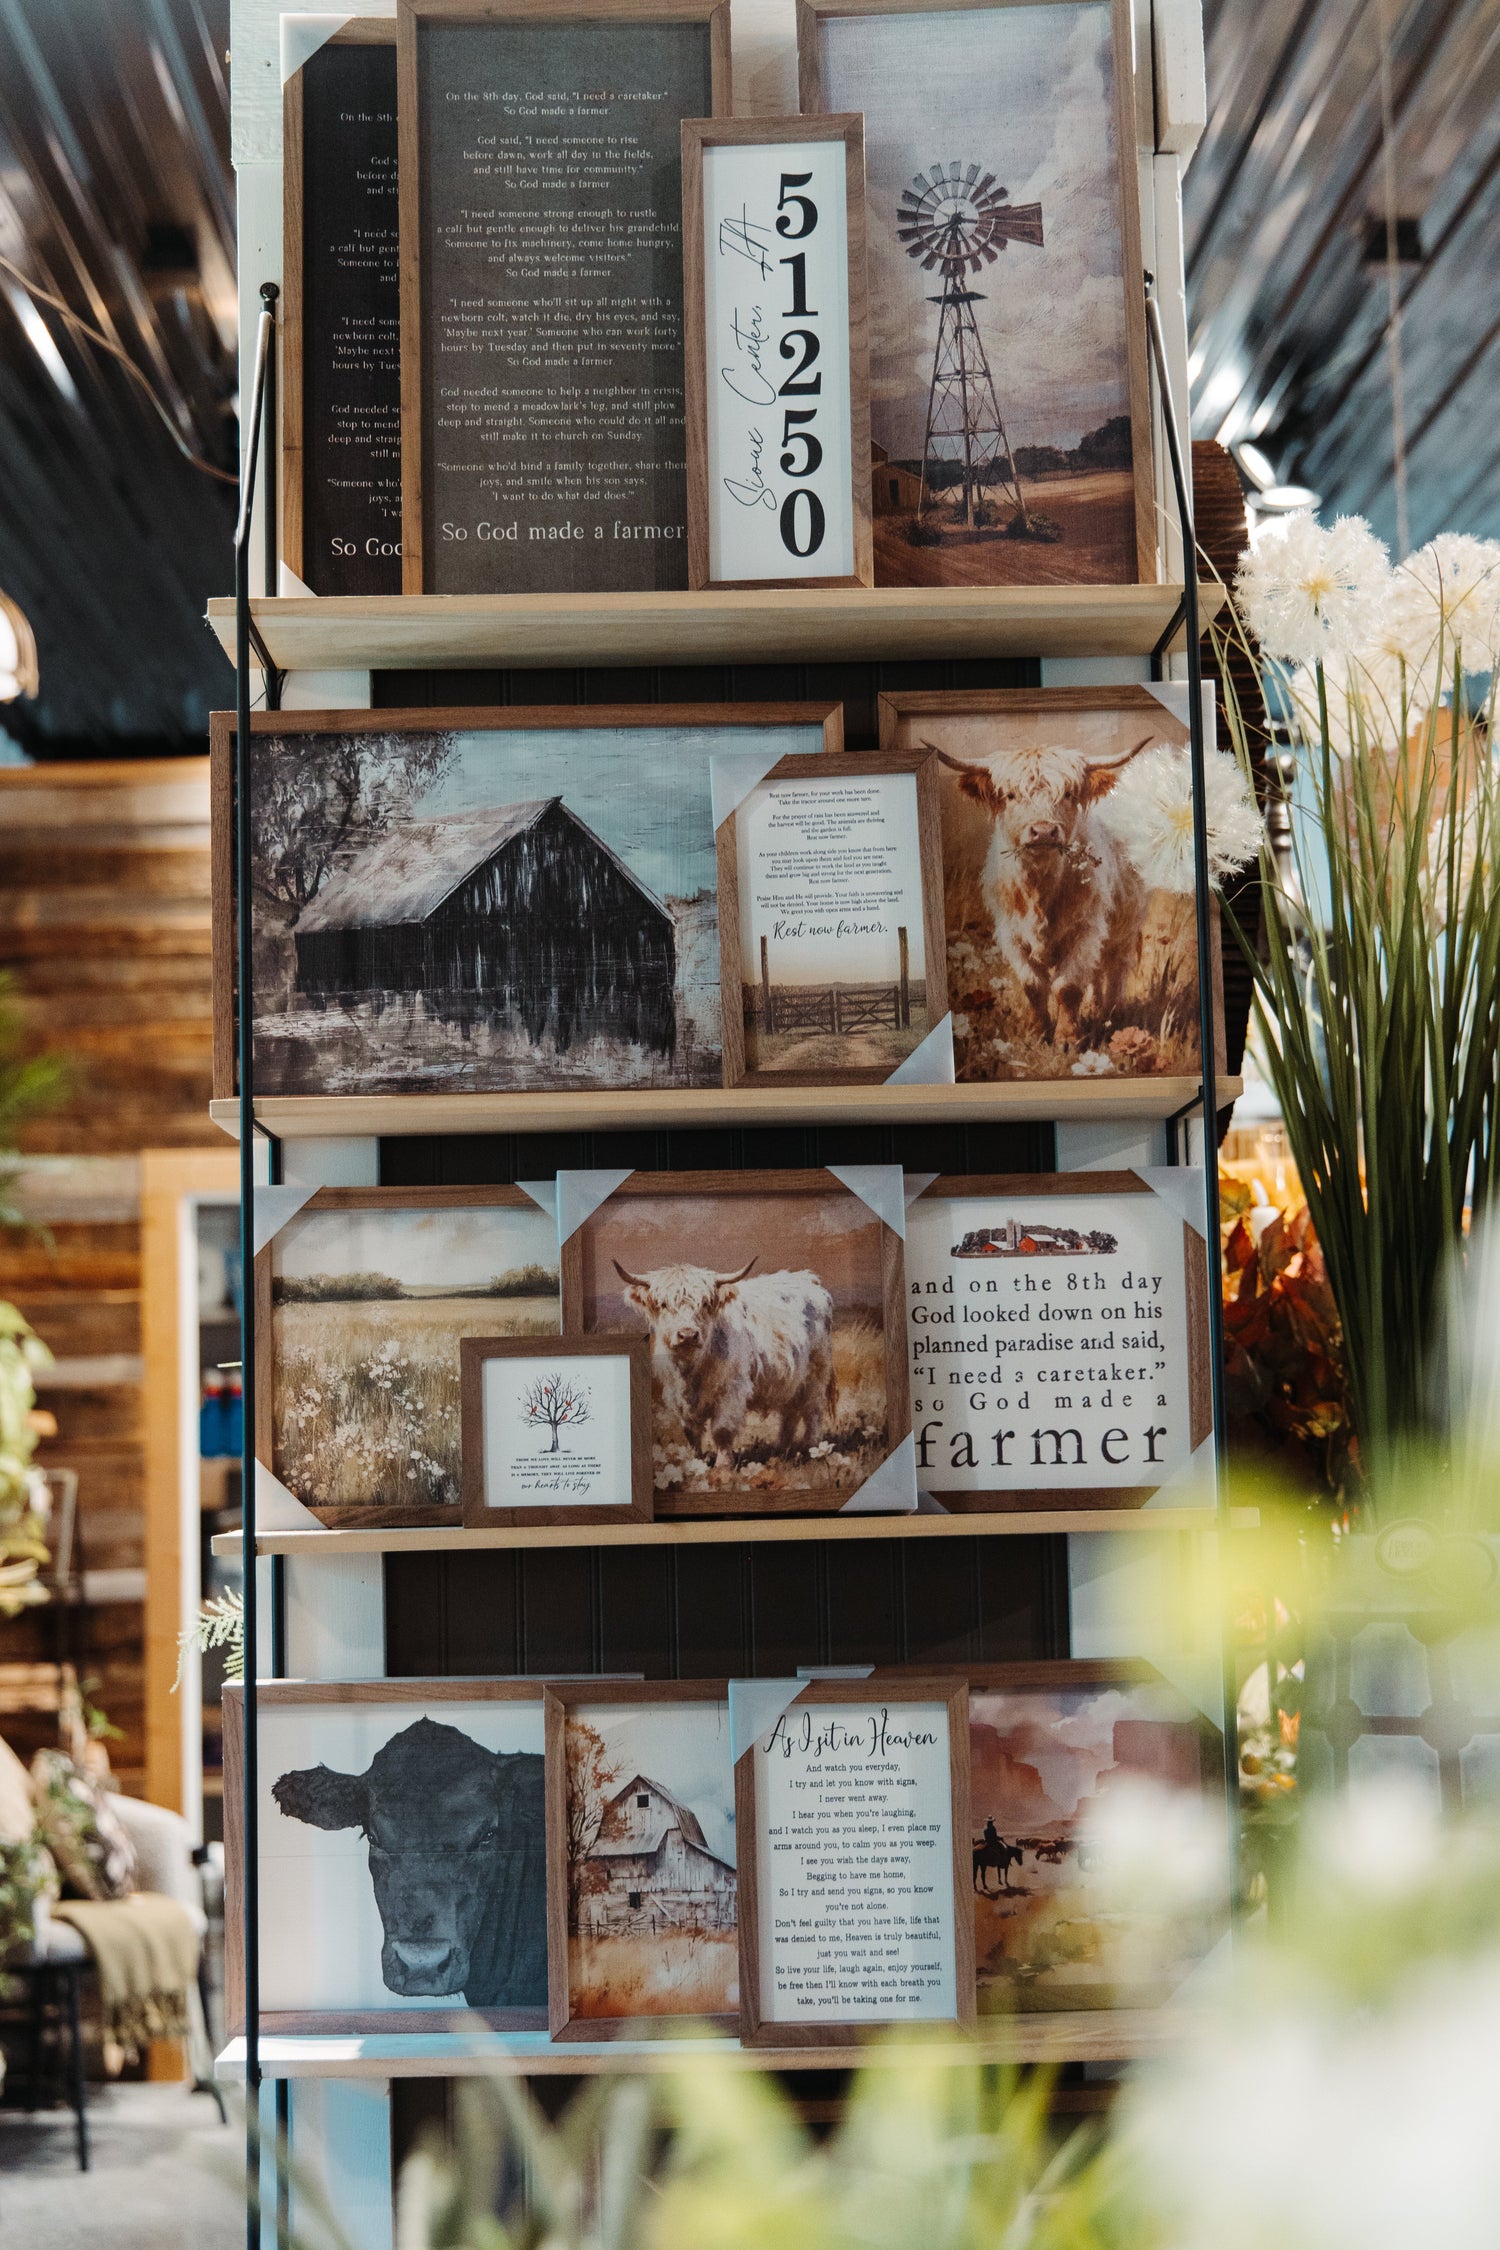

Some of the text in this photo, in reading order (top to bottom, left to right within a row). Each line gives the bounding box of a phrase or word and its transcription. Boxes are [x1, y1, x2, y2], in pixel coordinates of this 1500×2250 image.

[446, 92, 459, 101] On
[464, 92, 479, 101] the
[483, 92, 498, 101] 8th
[525, 92, 543, 100] God
[573, 92, 579, 100] "I
[584, 91, 605, 100] need
[504, 107, 515, 115] So
[519, 106, 537, 115] God
[542, 106, 566, 115] made
[340, 112, 393, 122] On the 8th
[478, 136, 496, 145] God
[525, 136, 532, 144] "I
[536, 136, 558, 144] need
[488, 254, 504, 263] and
[509, 253, 540, 265] always
[544, 253, 585, 262] welcome
[380, 273, 397, 282] and
[333, 332, 375, 341] newborn
[447, 404, 467, 414] stop
[484, 402, 510, 411] mend
[522, 401, 586, 410] meadowlark's
[612, 401, 628, 410] and
[632, 401, 650, 410] still
[655, 401, 675, 412] plow
[337, 420, 400, 430] stop to mend
[723, 427, 777, 510] Sioux
[506, 476, 523, 486] and
[527, 476, 552, 485] smile
[556, 476, 582, 485] when
[586, 476, 600, 485] his
[441, 523, 467, 541] So
[477, 522, 518, 541] God
[529, 521, 584, 539] made
[594, 526, 603, 539] a
[331, 538, 356, 556] So
[773, 919, 888, 940] Rest now farmer.
[912, 1270, 1162, 1295] and on the 8th day
[912, 1300, 1162, 1324] God looked down on his
[914, 1334, 988, 1360] planned
[995, 1332, 1073, 1358] paradise
[1081, 1331, 1115, 1350] and
[949, 1365, 1002, 1384] need
[1015, 1371, 1023, 1382] a
[915, 1389, 1167, 1412] so God made a
[915, 1422, 1167, 1468] farmer
[763, 1707, 938, 1758] As I sit in Heaven
[806, 1764, 822, 1772] And
[825, 1763, 846, 1771] watch
[849, 1765, 862, 1773] you
[795, 1780, 807, 1790] try
[810, 1779, 823, 1788] and
[826, 1779, 835, 1788] let
[855, 1777, 874, 1787] know
[877, 1778, 894, 1786] with
[817, 1812, 831, 1820] you
[834, 1809, 853, 1817] when
[856, 1808, 879, 1819] you're
[807, 1871, 837, 1882] Begging
[826, 1902, 849, 1912] you're
[776, 1966, 785, 1974] So
[787, 1965, 801, 1973] live
[803, 1967, 820, 1975] your
[840, 1964, 860, 1974] laugh
[888, 1963, 907, 1973] enjoy
[818, 1995, 839, 2007] you'll
[841, 1995, 851, 2004] be
[853, 1994, 877, 2005] taking
[896, 1994, 906, 2003] for
